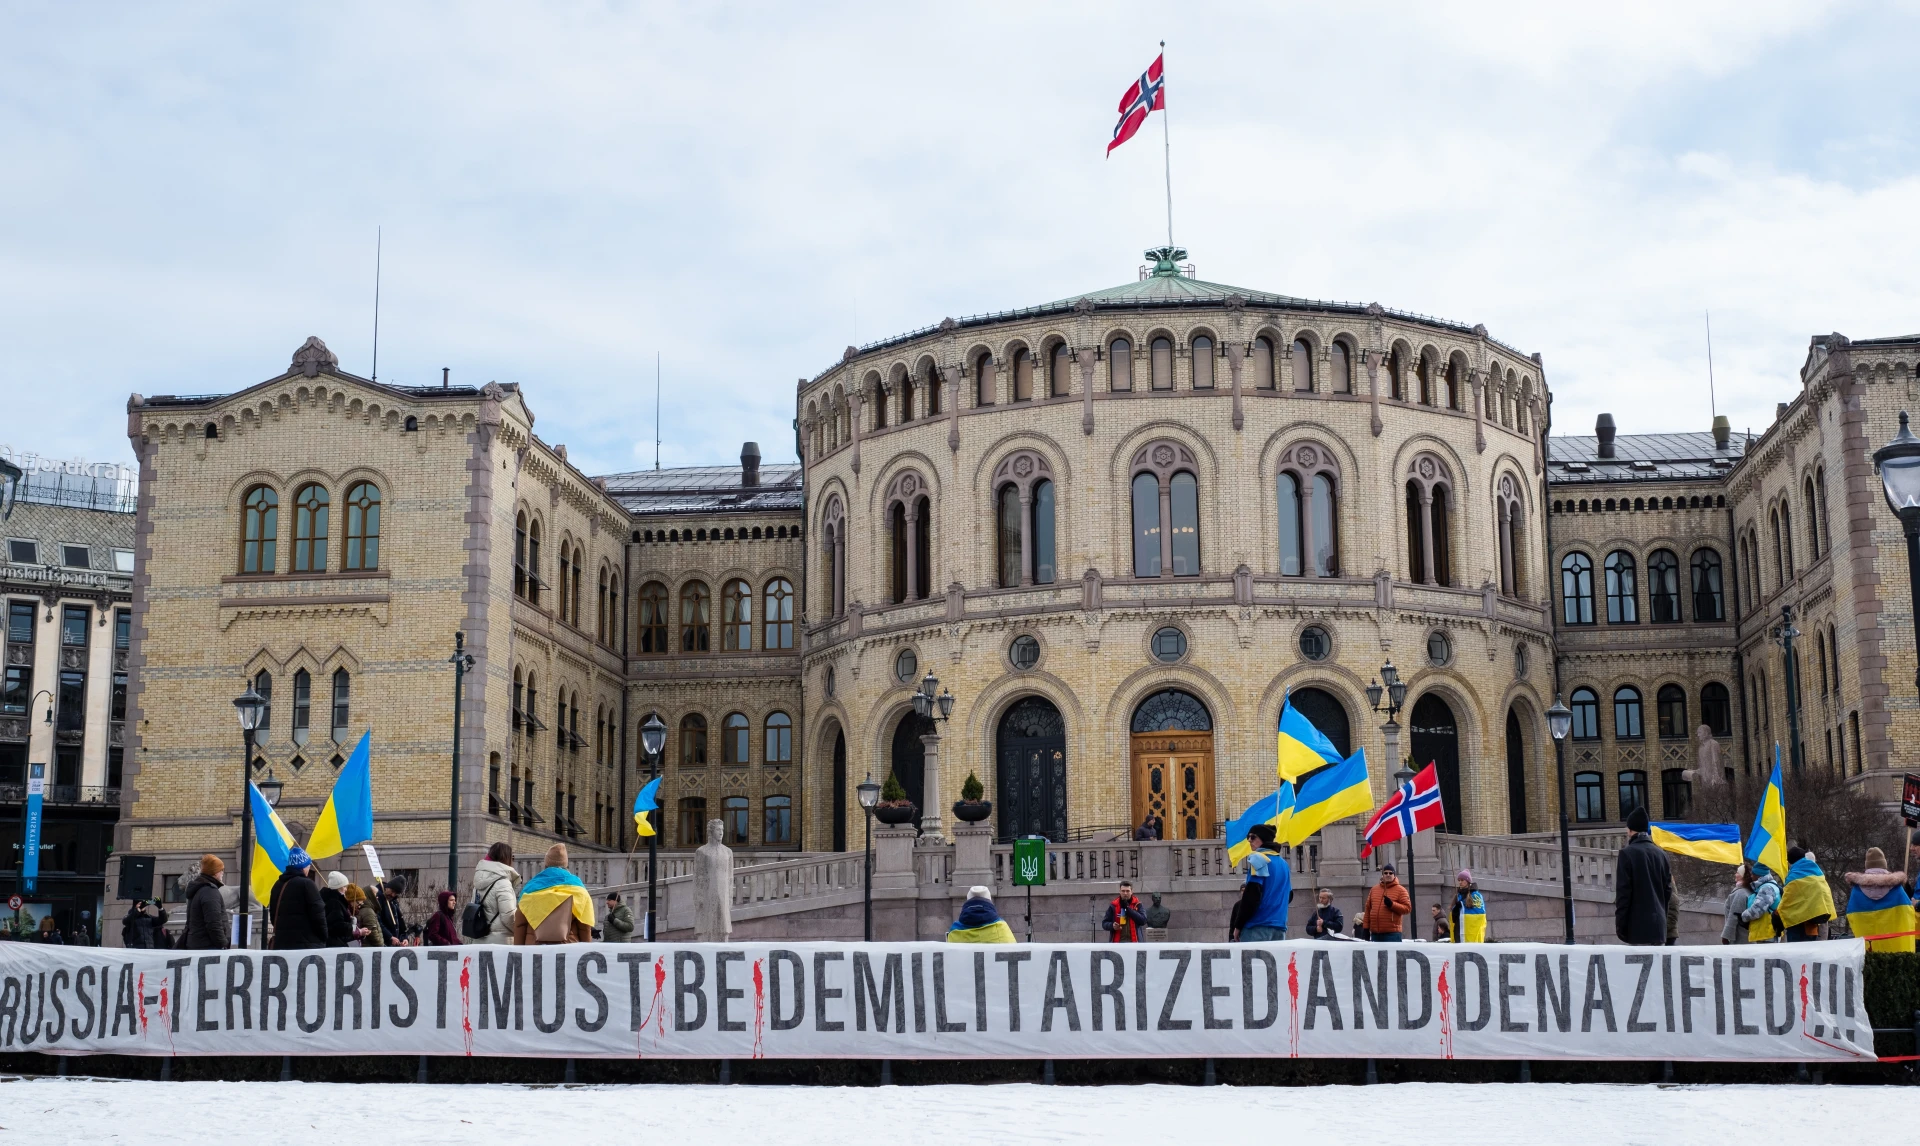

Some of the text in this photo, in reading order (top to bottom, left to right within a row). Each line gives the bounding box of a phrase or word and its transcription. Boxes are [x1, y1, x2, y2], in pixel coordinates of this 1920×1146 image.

[21, 451, 136, 480] Fjordkraft
[0, 963, 137, 1047] RUSSIA
[478, 951, 652, 1033] MUST
[674, 951, 746, 1032] BE
[769, 950, 1278, 1033] DEMILITARIZED
[1303, 950, 1432, 1030] AND
